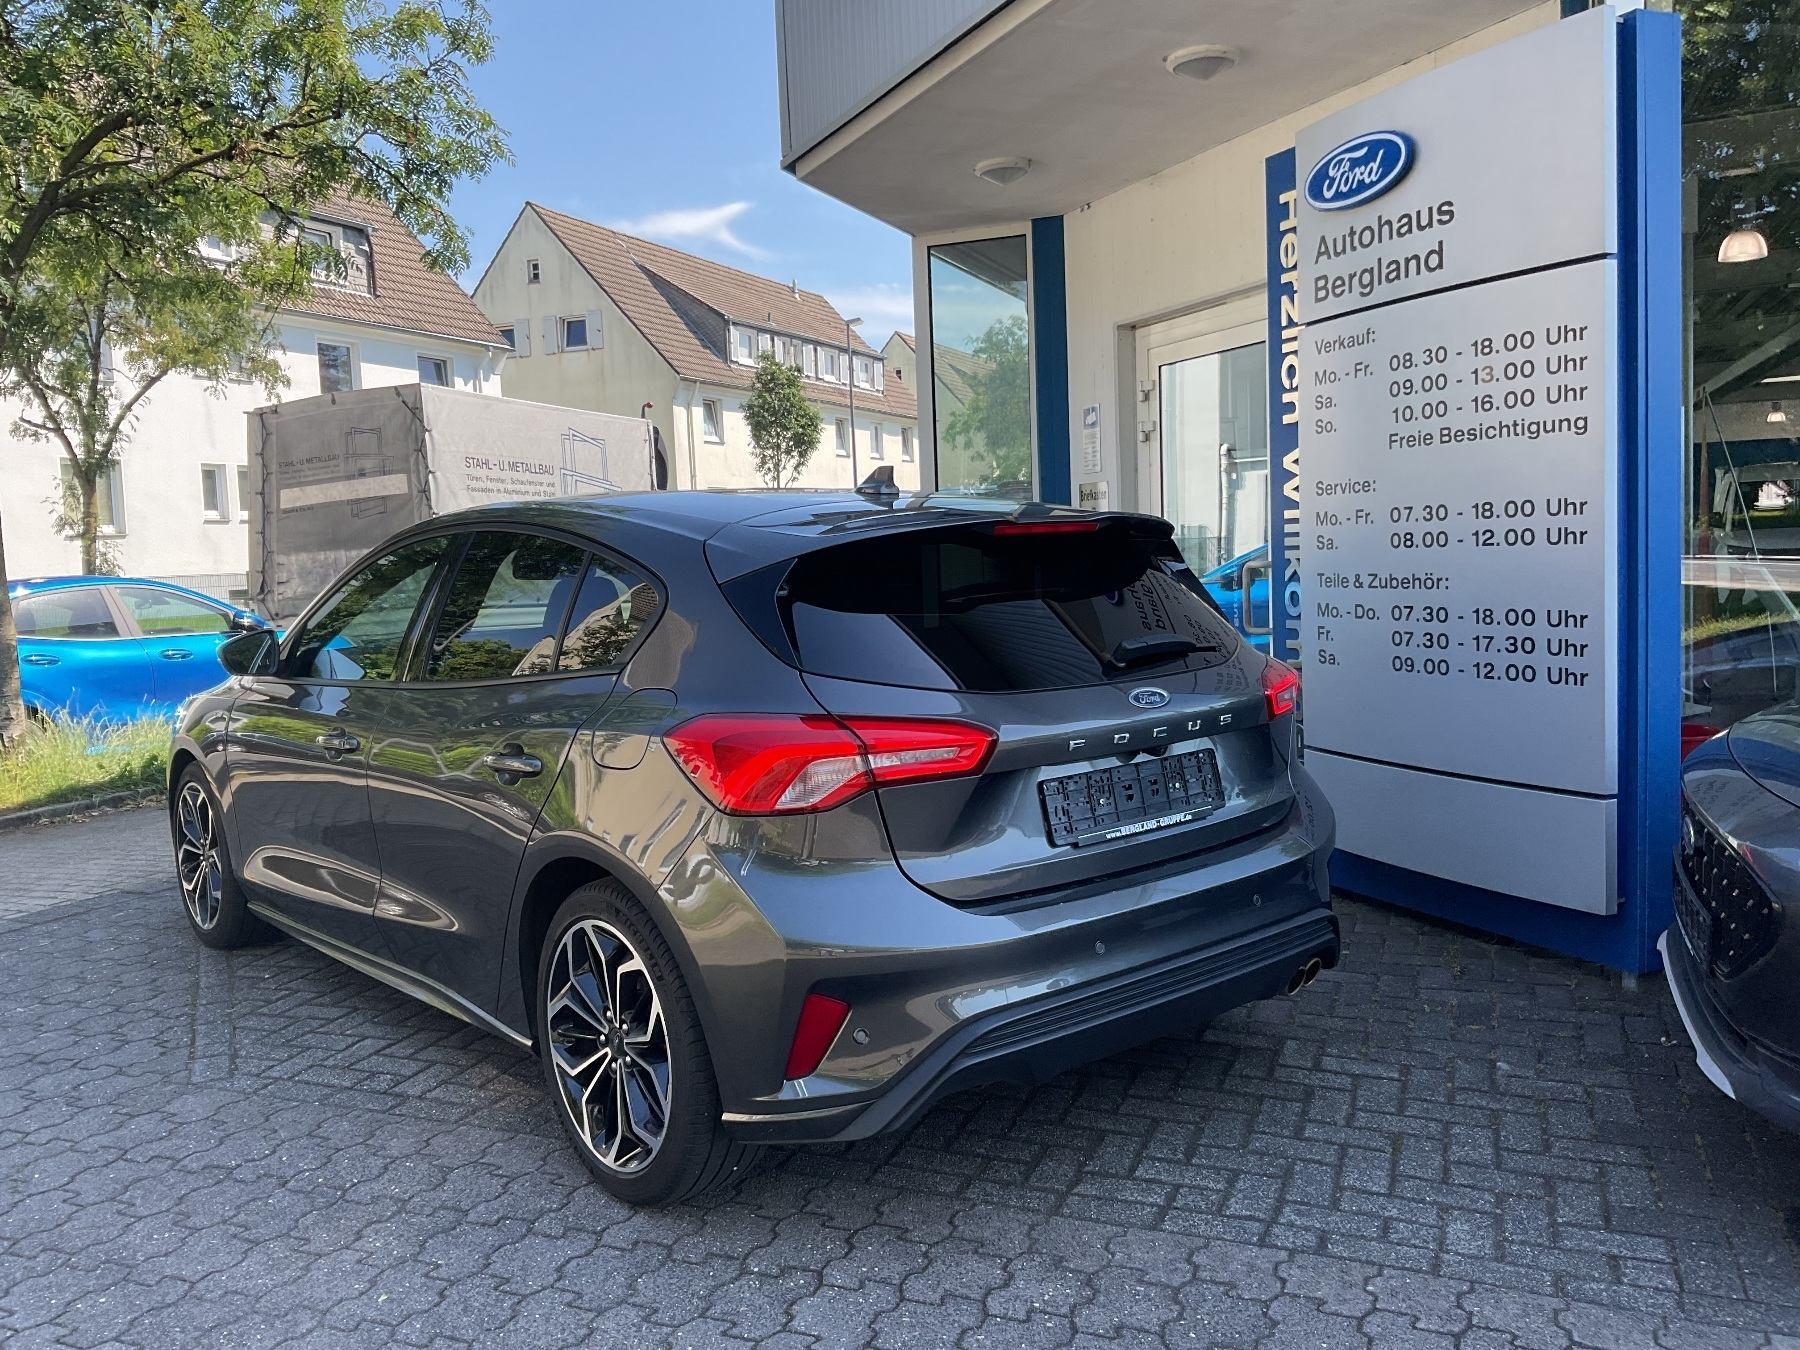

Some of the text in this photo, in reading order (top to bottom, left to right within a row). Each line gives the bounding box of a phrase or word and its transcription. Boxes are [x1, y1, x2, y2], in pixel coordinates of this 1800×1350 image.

[1313, 200, 1456, 265] Autohaus
[1313, 240, 1445, 304] Bergland
[1314, 327, 1377, 356] Verkauf:
[1388, 345, 1448, 372] 08.30
[1470, 330, 1536, 357] 18.00
[1545, 323, 1588, 347] Uhr
[1314, 394, 1337, 411] Sa.
[1388, 373, 1448, 398] 09.00
[1470, 359, 1536, 386] 13.00
[1545, 352, 1588, 376] Uhr
[1314, 419, 1337, 435] So.
[1391, 400, 1448, 425] 10.00
[1470, 387, 1536, 414] 16.00
[1545, 382, 1588, 405] Uhr
[1388, 414, 1589, 450] Freie Besichtigung
[508, 461, 555, 476] METALLBAU
[466, 485, 495, 494] Fassaden
[1315, 478, 1377, 496] Service:
[1389, 504, 1449, 524] 07.30
[1471, 499, 1536, 520] 18.00
[1546, 497, 1588, 518] Uhr
[1316, 535, 1338, 551] Sa.
[1390, 531, 1449, 549] 08.00
[1471, 528, 1536, 548] 12.00
[1546, 526, 1588, 546] Uhr
[1317, 573, 1449, 590] Teile & Zubehör:
[1391, 605, 1449, 624] 07.30
[1471, 607, 1536, 627] 18.00
[1546, 609, 1588, 629] Uhr
[1317, 626, 1334, 642] Fr.
[1391, 630, 1449, 650] 07.30
[1471, 634, 1536, 655] 17.30
[1546, 638, 1588, 658] Uhr
[1318, 649, 1340, 666] Sa.
[1391, 656, 1450, 677] 09.00
[1472, 662, 1537, 683] 12.00
[1546, 666, 1589, 687] Uhr
[1069, 713, 1232, 751] FOCUS
